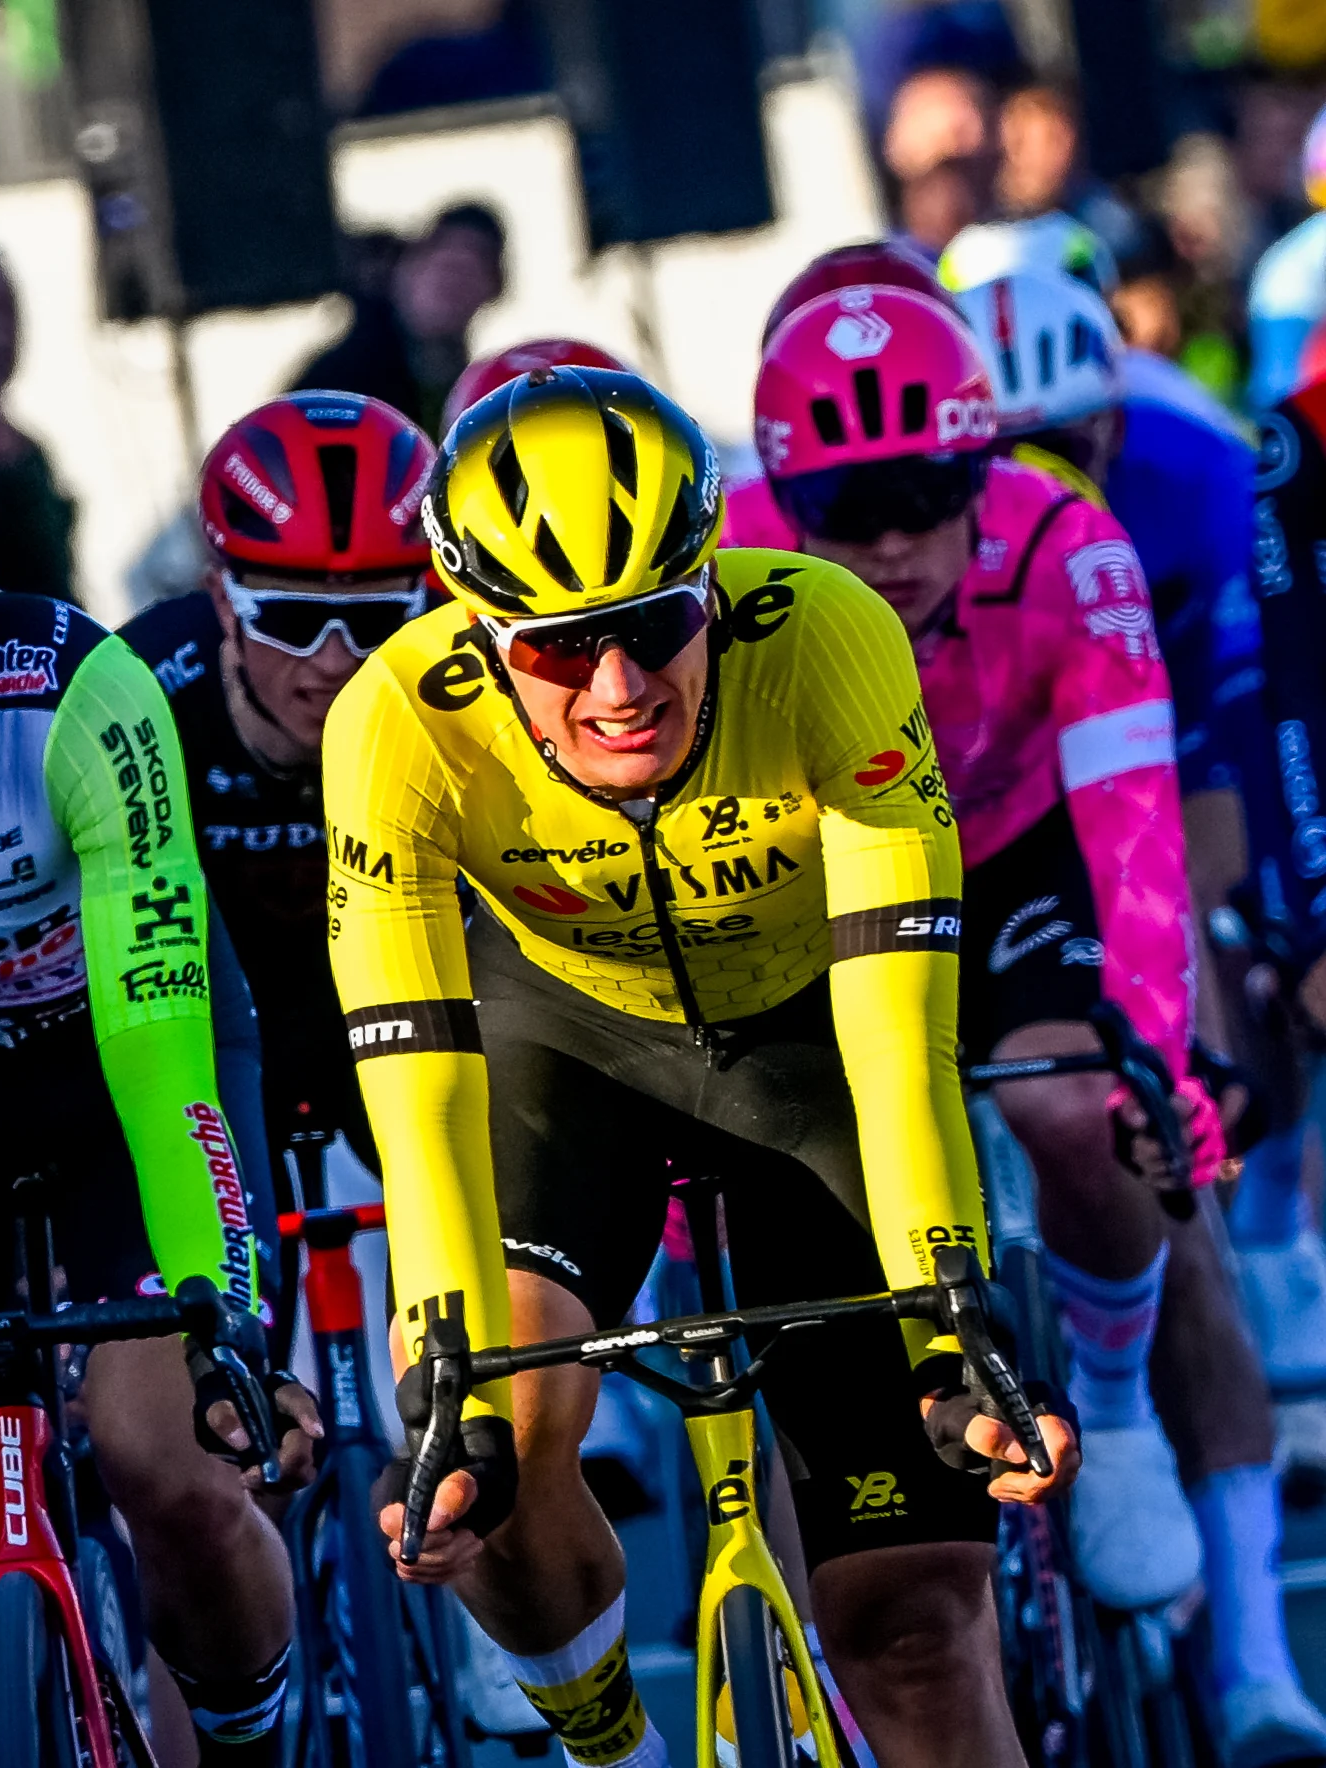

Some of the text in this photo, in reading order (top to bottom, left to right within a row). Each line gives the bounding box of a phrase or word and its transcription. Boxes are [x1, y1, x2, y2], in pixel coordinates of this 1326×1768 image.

[99, 720, 152, 869] STEVENY
[133, 716, 173, 850] SKODA
[203, 822, 327, 851] TUD
[500, 838, 631, 865] cervélo
[603, 845, 801, 913] VISMA
[682, 1326, 725, 1339] GARMIN
